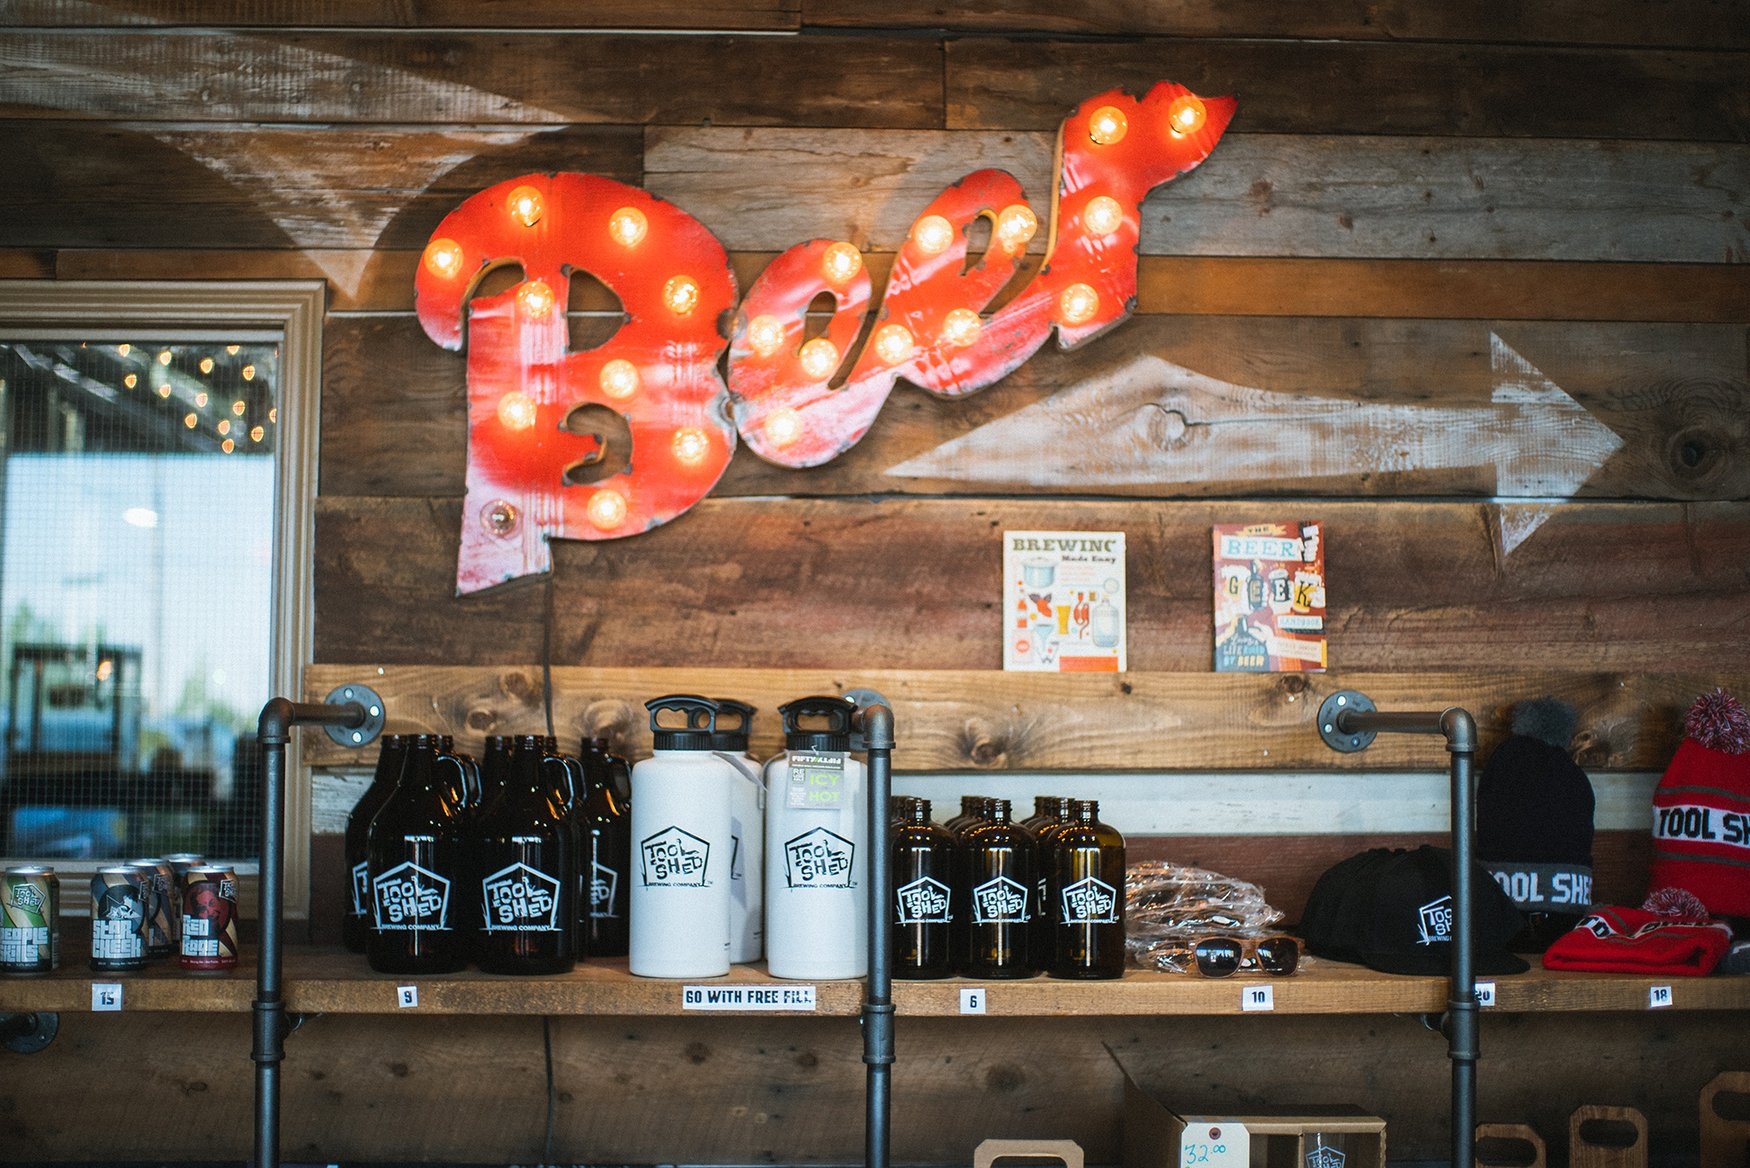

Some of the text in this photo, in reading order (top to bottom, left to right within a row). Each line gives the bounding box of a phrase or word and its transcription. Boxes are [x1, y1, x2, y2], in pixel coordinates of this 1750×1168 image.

[415, 80, 1238, 597] Beer
[1013, 539, 1116, 552] BREWING
[1227, 539, 1295, 557] BEER
[1229, 576, 1311, 607] GEEK
[810, 774, 839, 785] ICY
[809, 791, 839, 801] HOT
[1659, 807, 1716, 839] TOOL
[645, 838, 699, 866] TOOL
[789, 839, 845, 867] TOOL
[655, 856, 703, 880] SHED
[801, 857, 848, 881] SHED
[378, 876, 439, 907] TOOL
[487, 876, 549, 908] TOOL
[902, 886, 945, 908] TOOL
[978, 885, 1021, 908] TOOL
[1066, 886, 1110, 908] TOOL
[1488, 871, 1544, 902] OOL
[388, 895, 442, 923] SHED
[499, 895, 552, 923] SHED
[911, 899, 946, 919] SHED
[987, 898, 1023, 918] SHED
[1076, 899, 1112, 919] SHED
[1423, 906, 1452, 926] TOO
[92, 920, 136, 939] STAR
[183, 915, 210, 936] RED
[100, 992, 114, 1005] 15
[707, 990, 742, 1003] WiTH
[747, 990, 778, 1004] FREE
[969, 995, 978, 1008] 6
[1251, 991, 1266, 1003] 10
[1653, 989, 1667, 1001] 18
